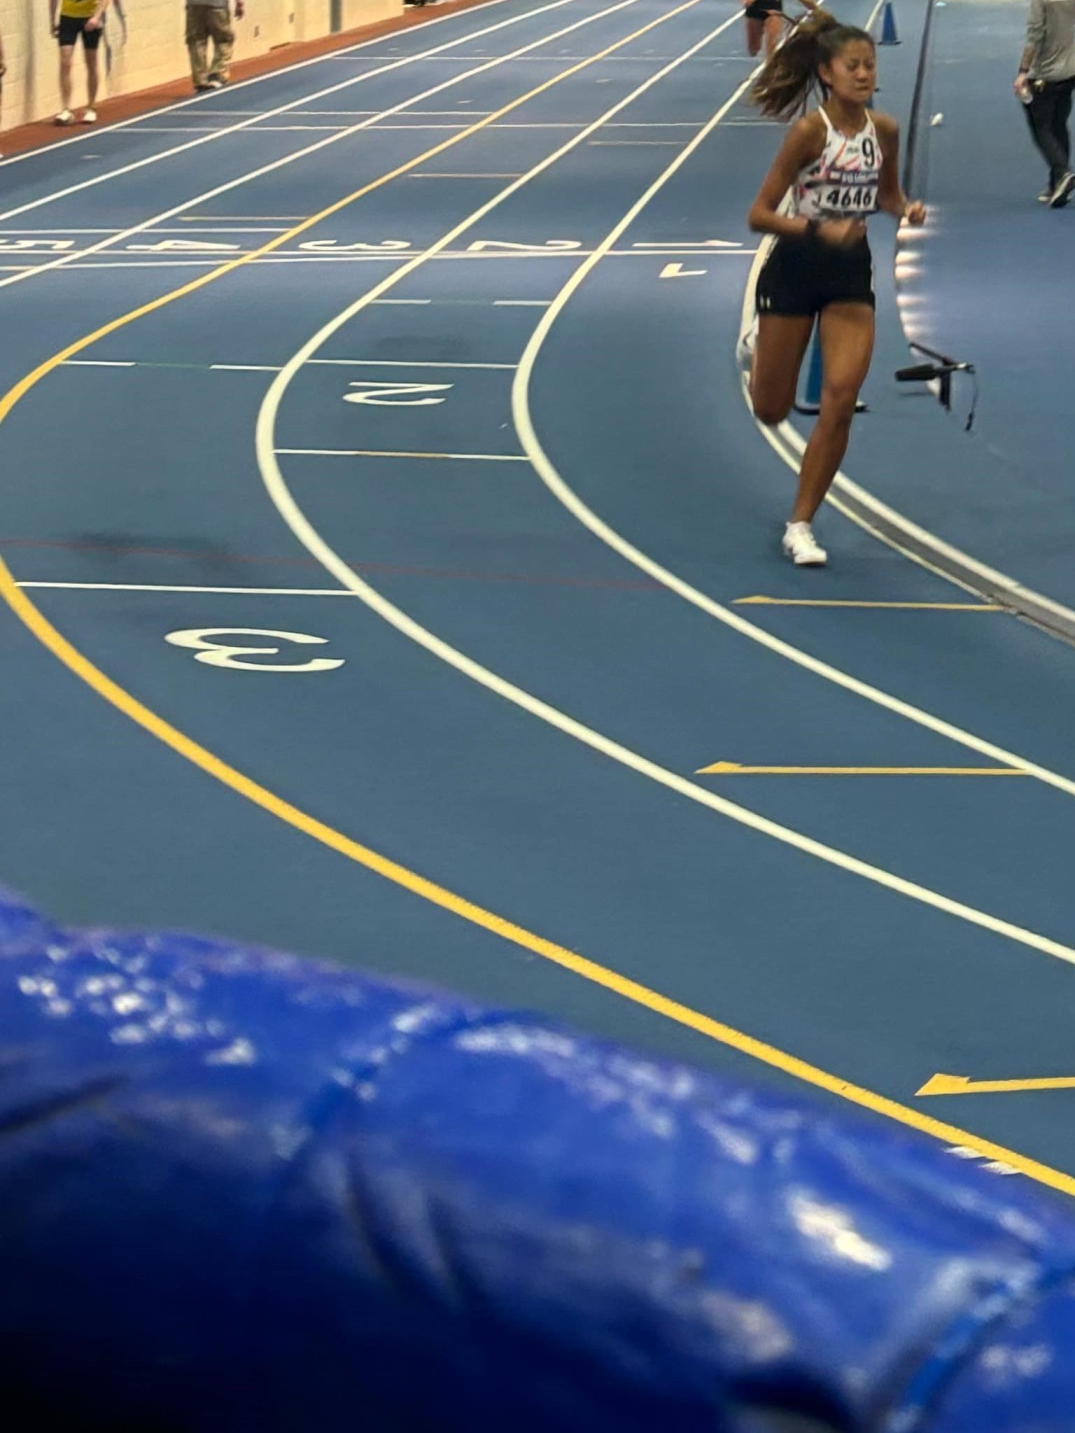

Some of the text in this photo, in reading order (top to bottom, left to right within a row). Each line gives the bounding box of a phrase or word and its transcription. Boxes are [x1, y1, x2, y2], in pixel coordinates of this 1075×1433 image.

[862, 137, 875, 169] 9
[126, 239, 241, 251] 4
[298, 239, 412, 251] 3
[466, 240, 582, 252] 2
[342, 381, 455, 406] 2
[164, 627, 346, 672] 3
